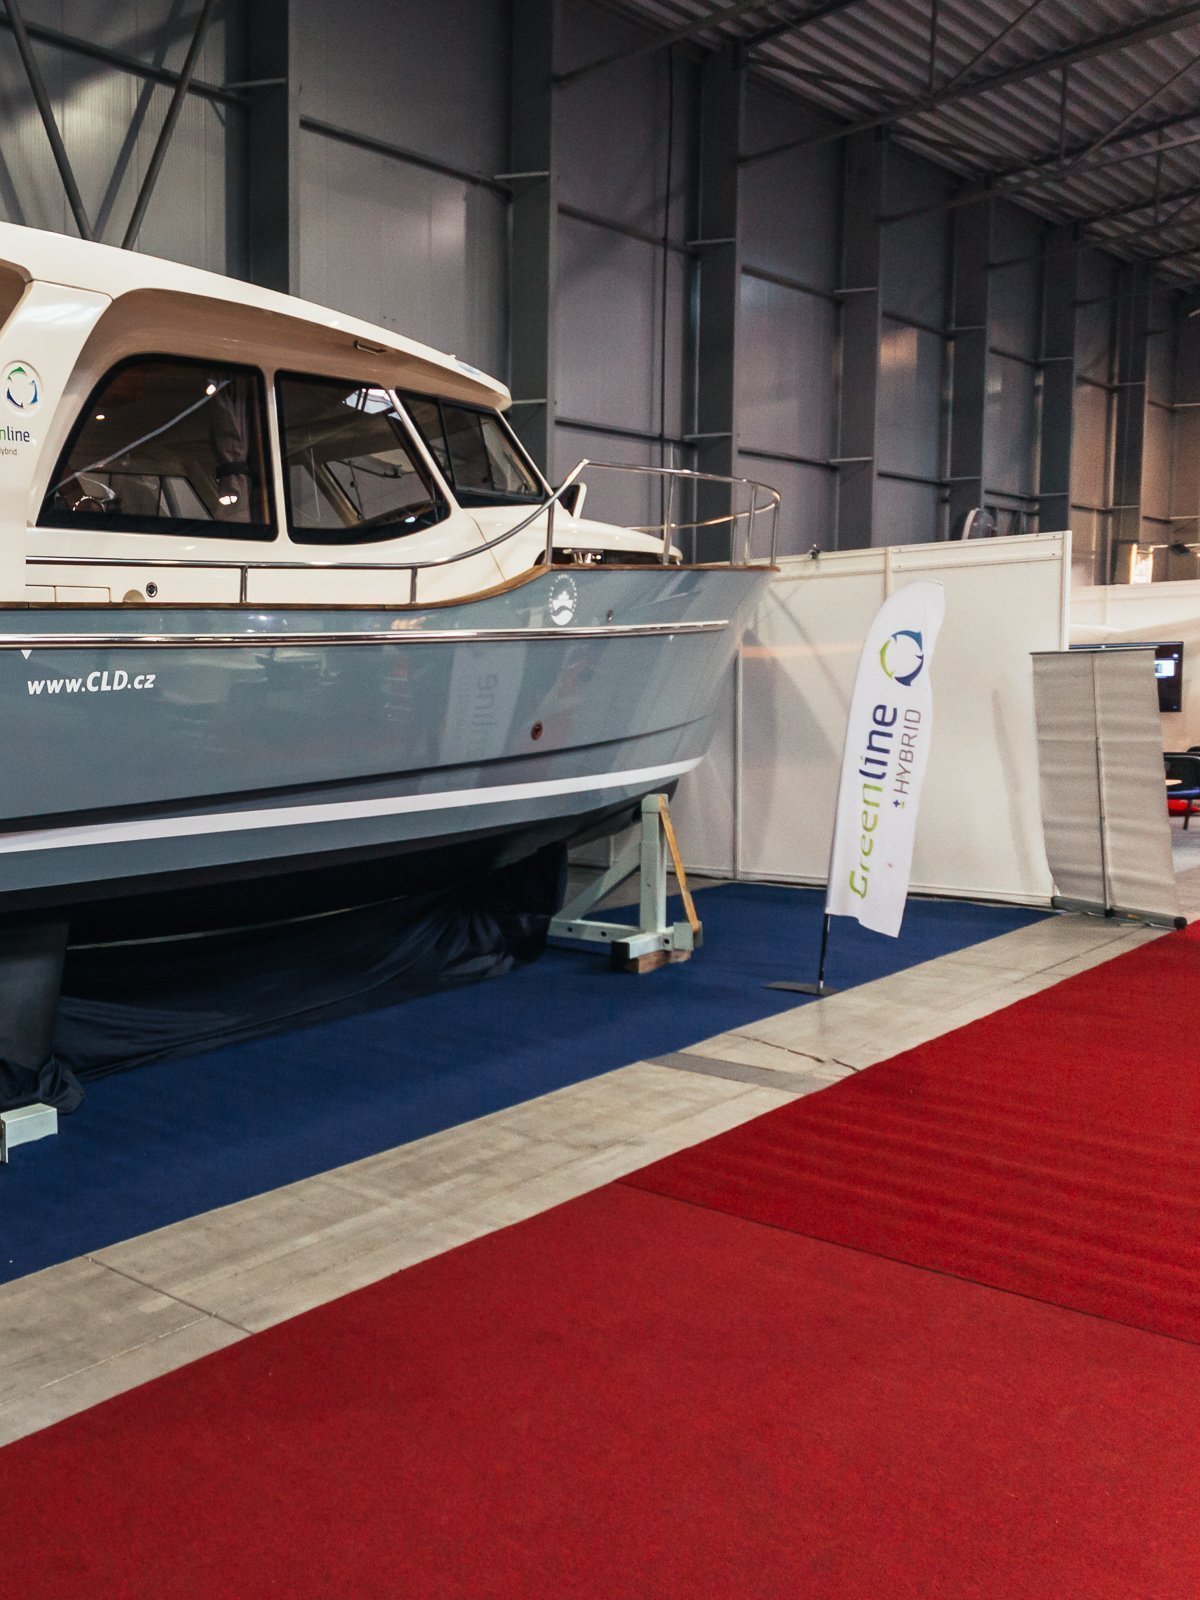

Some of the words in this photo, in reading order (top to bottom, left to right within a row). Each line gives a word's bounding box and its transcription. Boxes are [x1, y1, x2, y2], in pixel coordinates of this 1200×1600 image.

[27, 670, 157, 695] www.CLD.cz
[893, 709, 922, 796] HYBRID
[849, 704, 898, 899] Greenline
